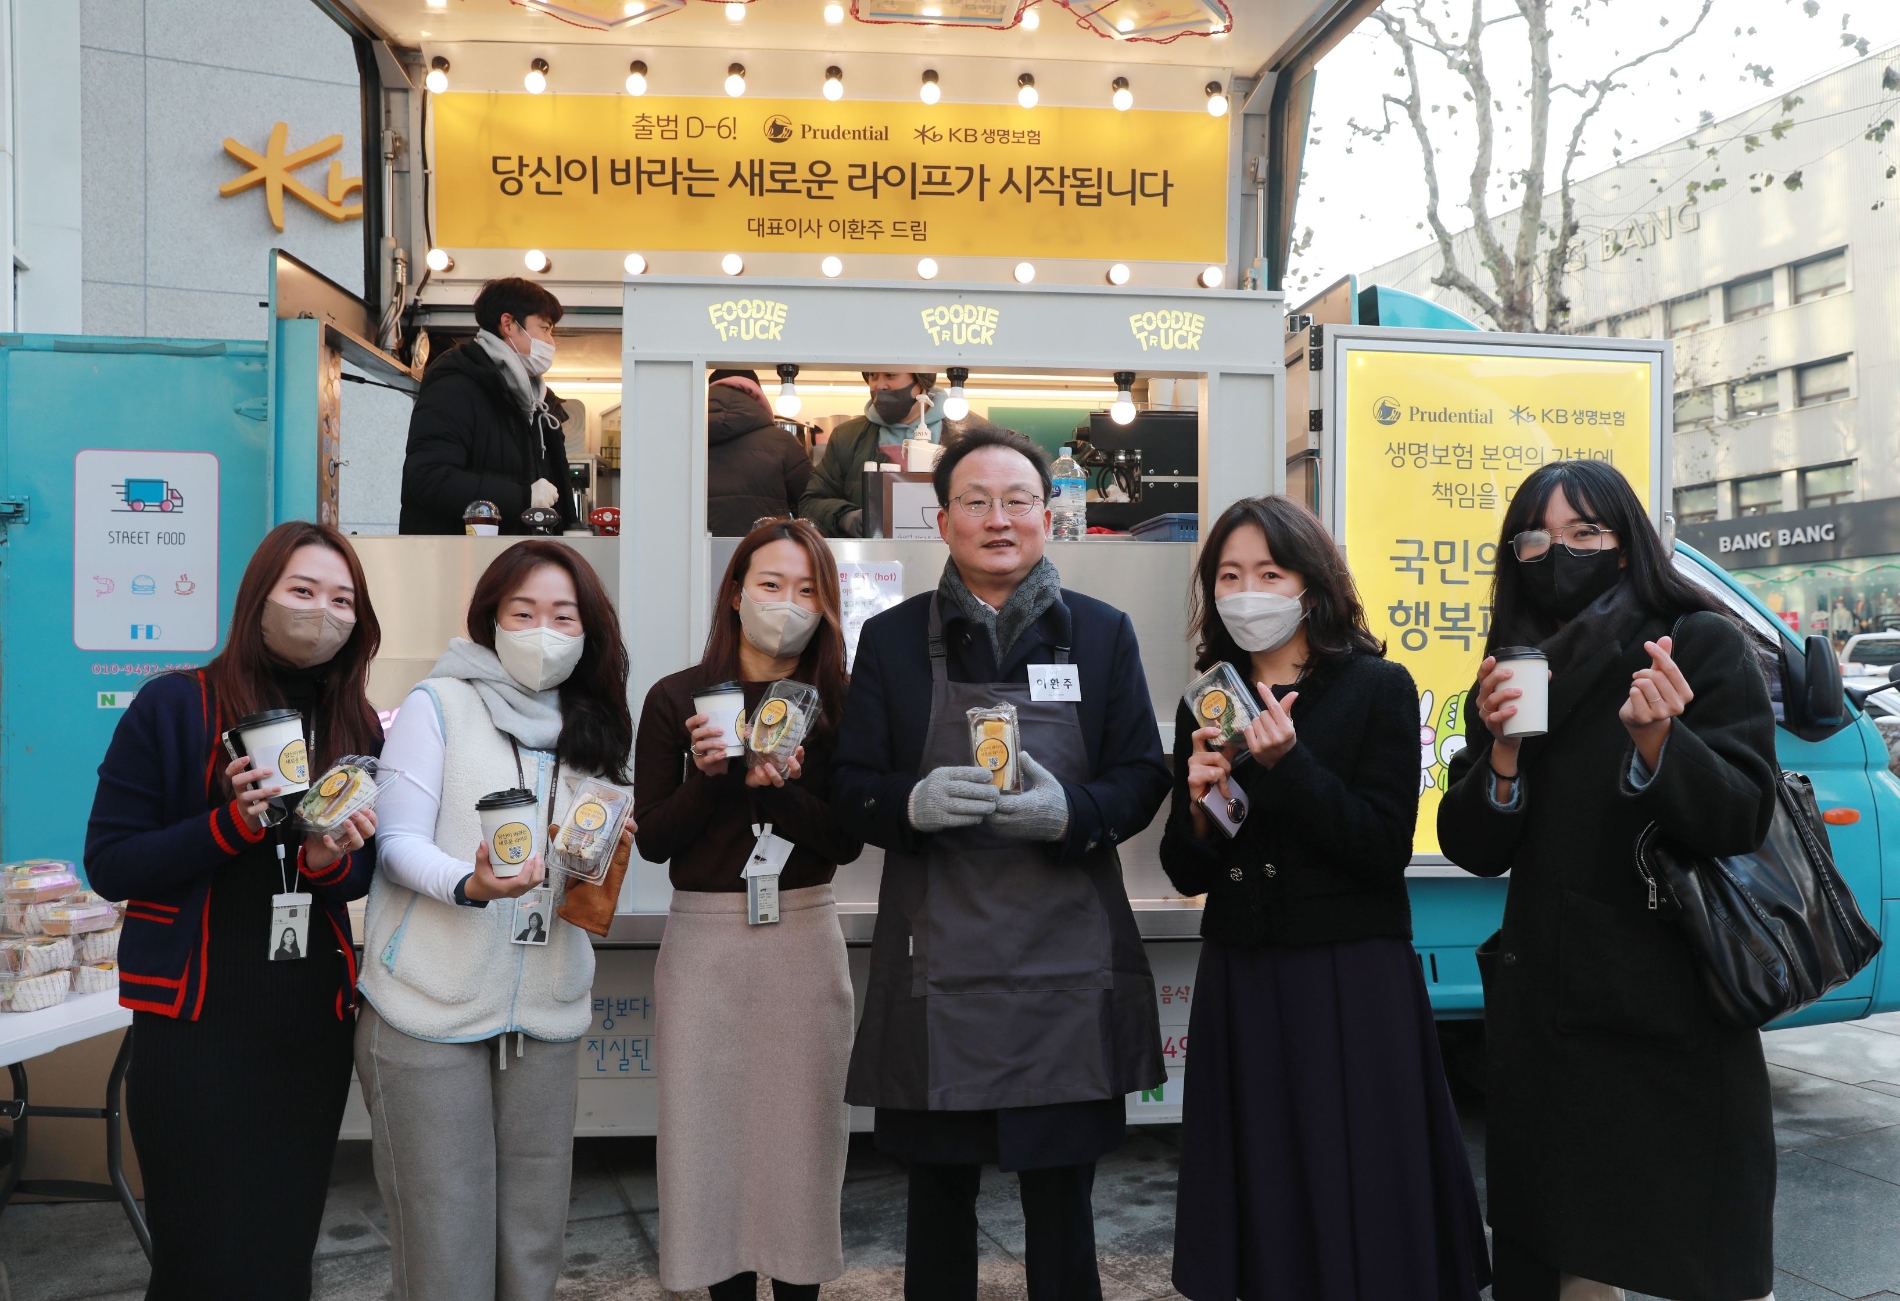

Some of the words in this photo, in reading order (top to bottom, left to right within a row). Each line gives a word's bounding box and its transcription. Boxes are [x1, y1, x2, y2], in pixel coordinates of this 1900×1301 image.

[631, 113, 679, 140] 출범
[686, 115, 738, 141] D-6!
[799, 122, 890, 142] Prudential
[948, 127, 978, 144] KB
[981, 127, 1042, 146] 생명보험
[491, 154, 599, 197] 당신이
[609, 155, 720, 199] 바라는
[727, 157, 840, 201] 새로운
[847, 160, 992, 203] 라이프가
[998, 164, 1175, 209] 시작됩니다
[746, 216, 824, 239] 대표이사
[828, 217, 886, 241] 이환주
[889, 219, 928, 243] 드림
[1602, 200, 1700, 262] BANG
[708, 299, 789, 324] FOODIE
[920, 305, 1000, 330] FOODIE
[1128, 310, 1206, 336] FOODIE
[714, 322, 784, 342] TRUCK
[928, 324, 996, 346] TRUCK
[1136, 330, 1204, 352] TRUCK
[1408, 405, 1494, 425] Prudential
[1542, 409, 1568, 424] KB
[1571, 409, 1626, 427] 생명보험
[1384, 441, 1474, 471] 생명보험
[1480, 444, 1545, 471] 본연의
[1432, 481, 1498, 510] 책임을
[108, 530, 150, 545] STREET
[157, 532, 187, 546] FOOD
[1719, 531, 1772, 553] BANG
[1777, 523, 1835, 547] BANG
[874, 572, 897, 581] (hot)
[1160, 985, 1192, 1004] 음식
[587, 1038, 651, 1072] 진실된
